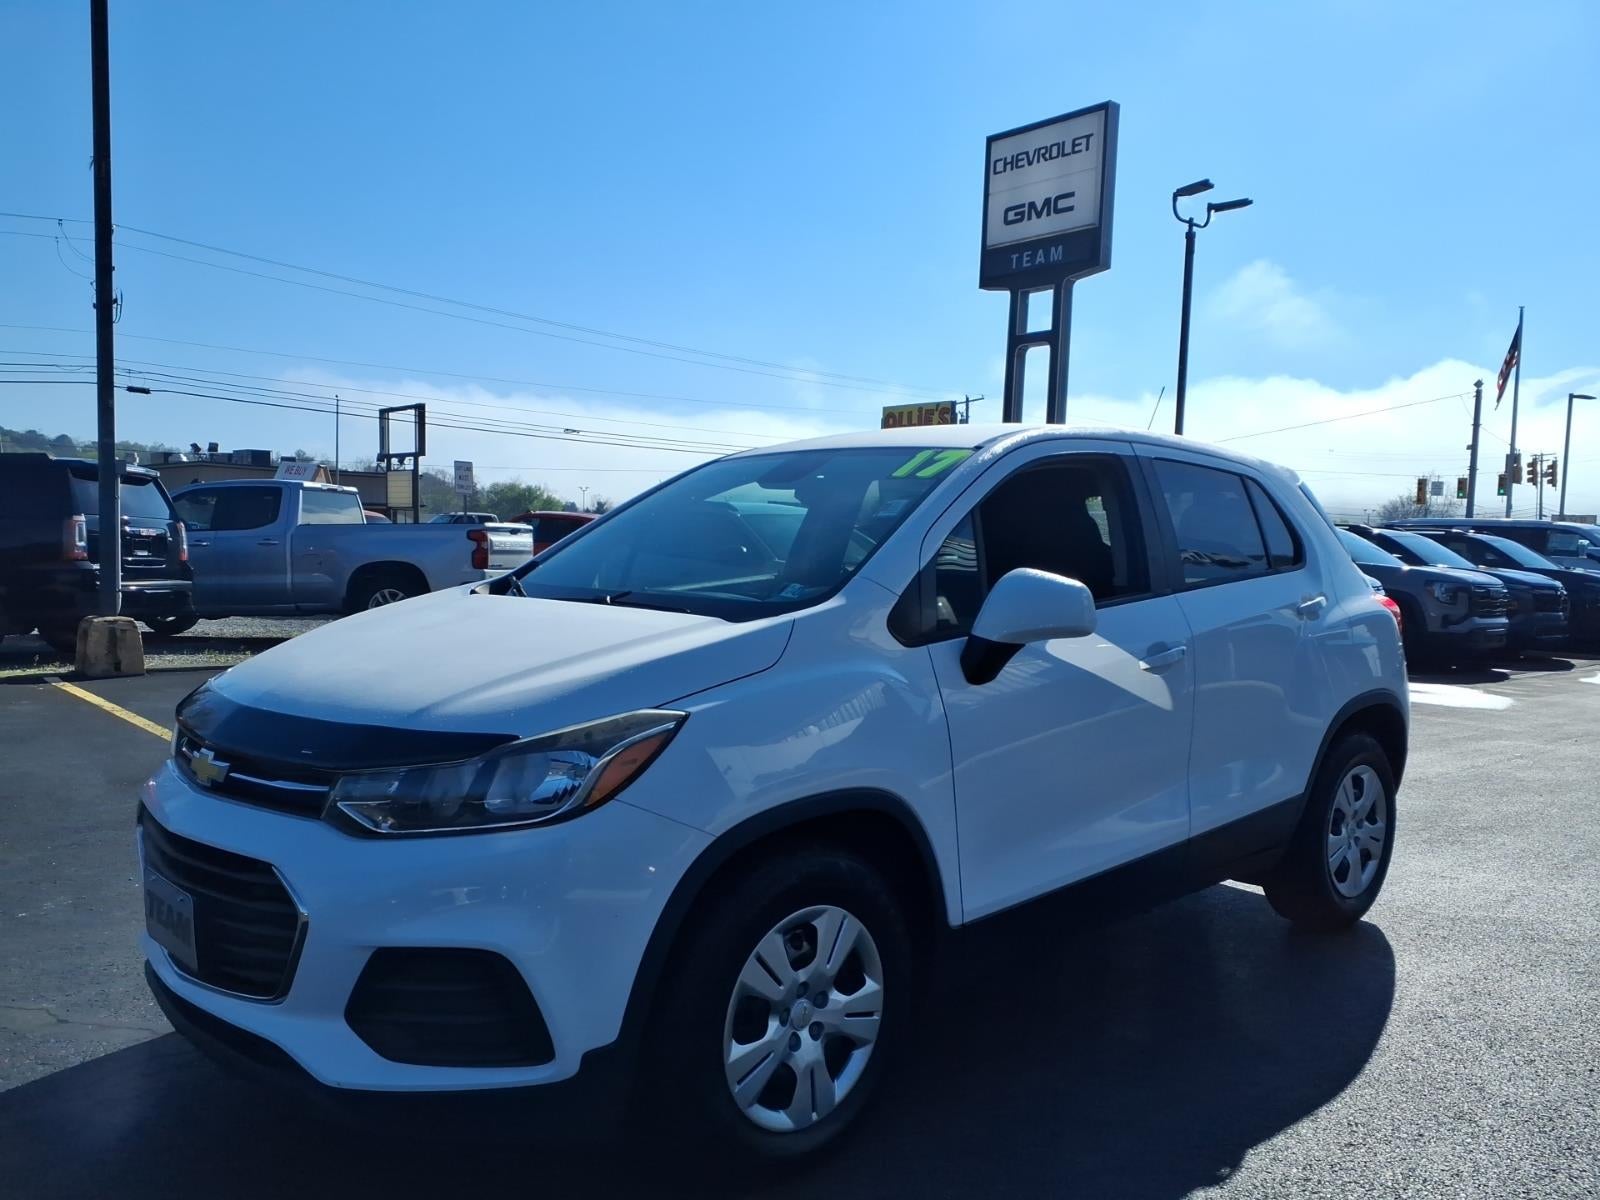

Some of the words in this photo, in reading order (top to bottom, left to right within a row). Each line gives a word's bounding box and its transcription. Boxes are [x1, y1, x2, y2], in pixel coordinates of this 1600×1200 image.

[993, 133, 1094, 175] CHEVROLET
[1003, 191, 1075, 226] GMC
[1010, 244, 1063, 269] TEAM
[891, 448, 976, 479] 17
[145, 888, 192, 947] TEAM
